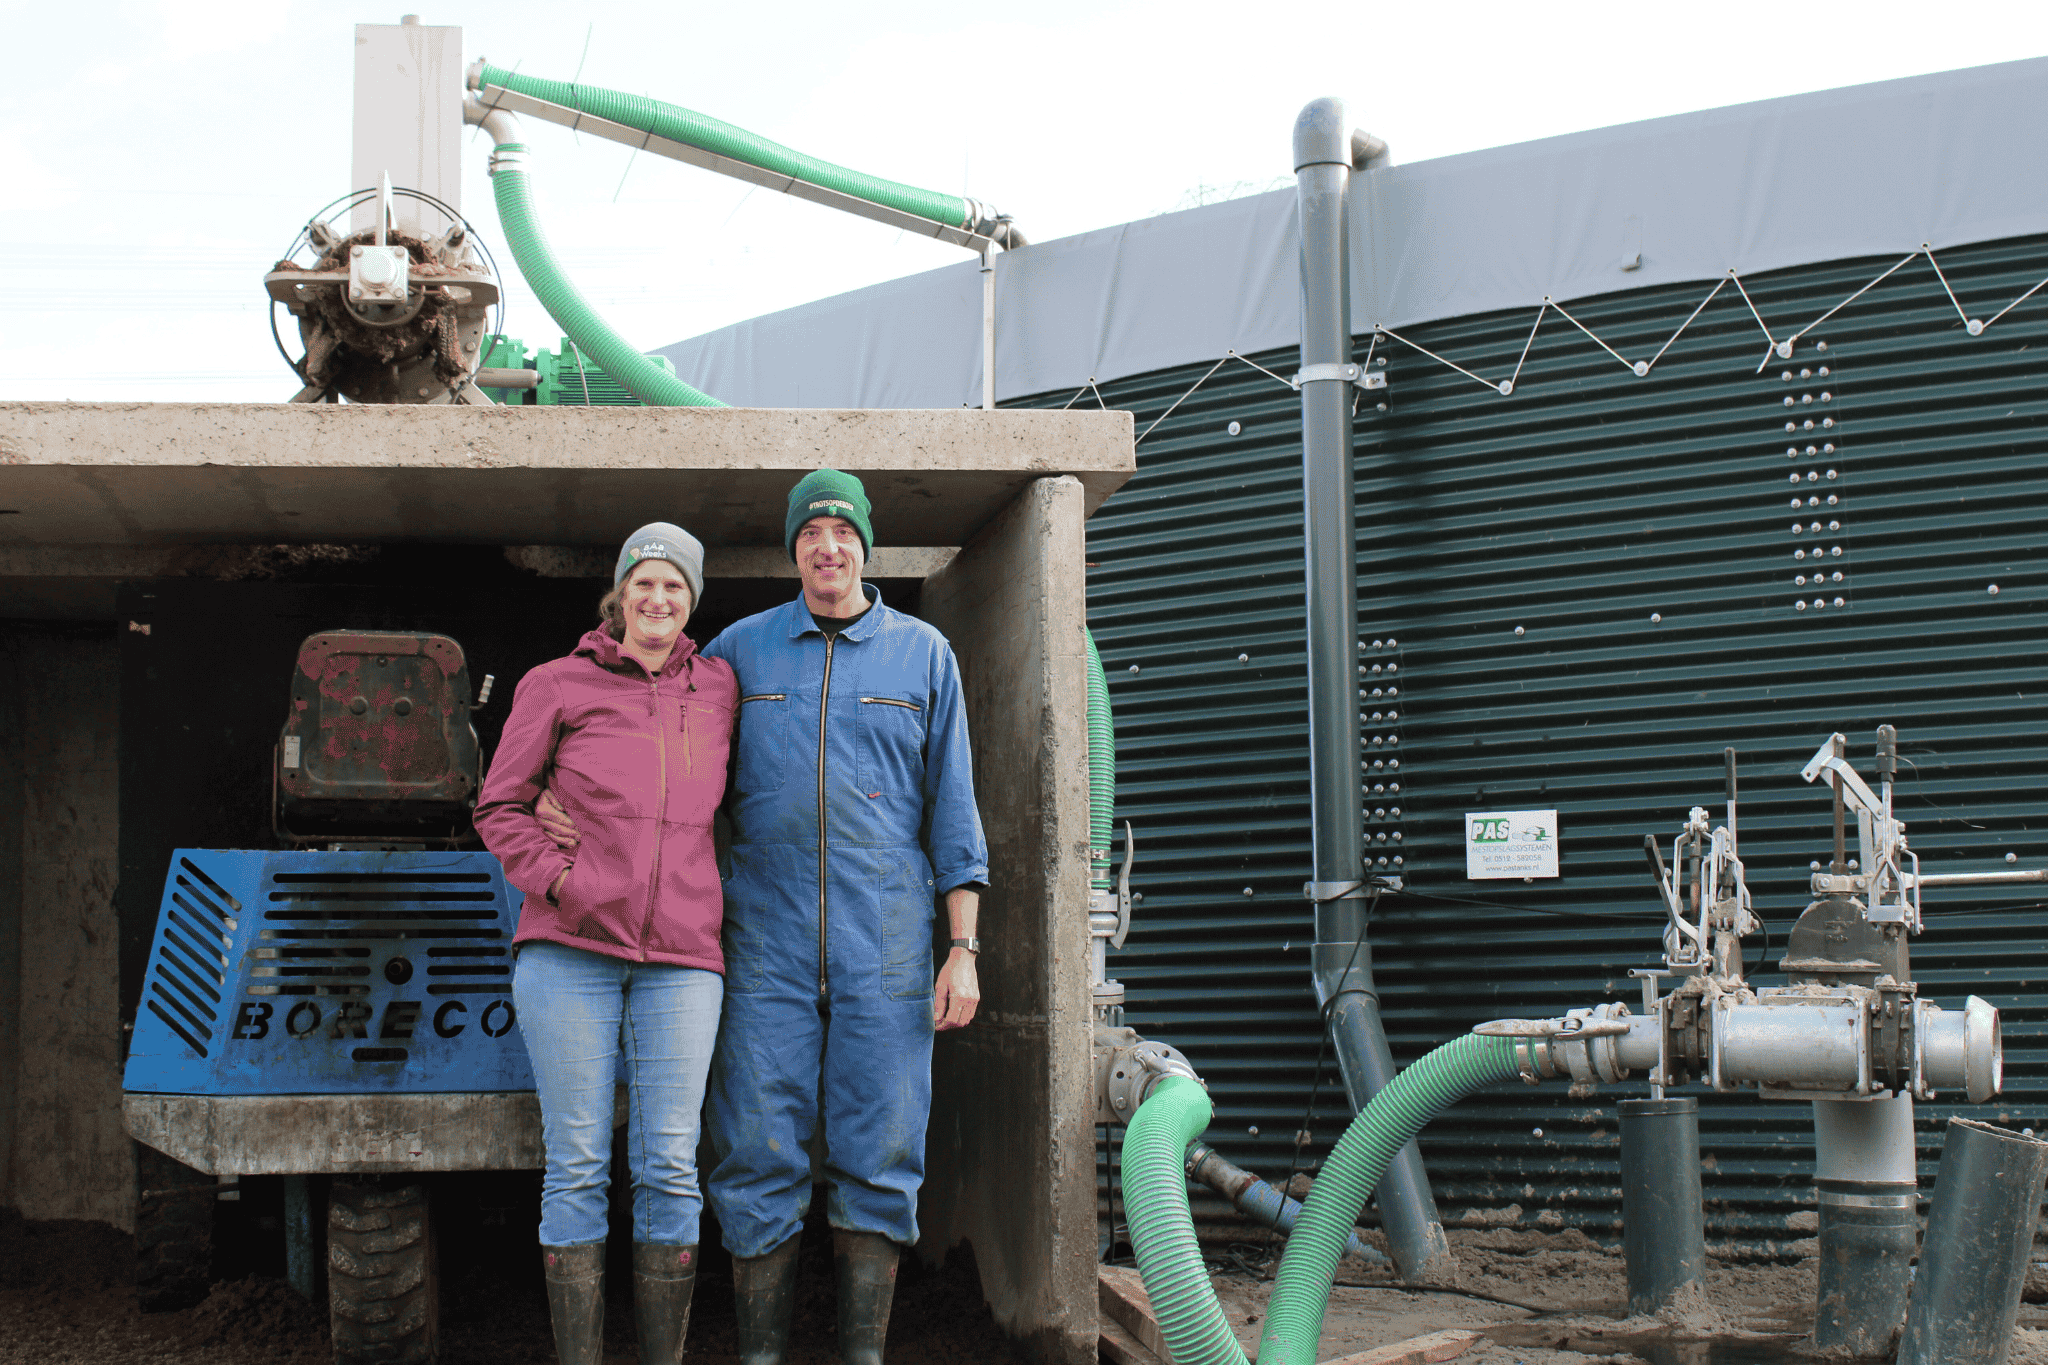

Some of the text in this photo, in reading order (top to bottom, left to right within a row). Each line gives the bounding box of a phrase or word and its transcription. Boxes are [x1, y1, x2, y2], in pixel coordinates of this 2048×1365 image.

[1471, 820, 1509, 841] PAS
[1471, 844, 1552, 853] MESTOPSLAGSYSTEMEN
[231, 1000, 516, 1040] BORECO
